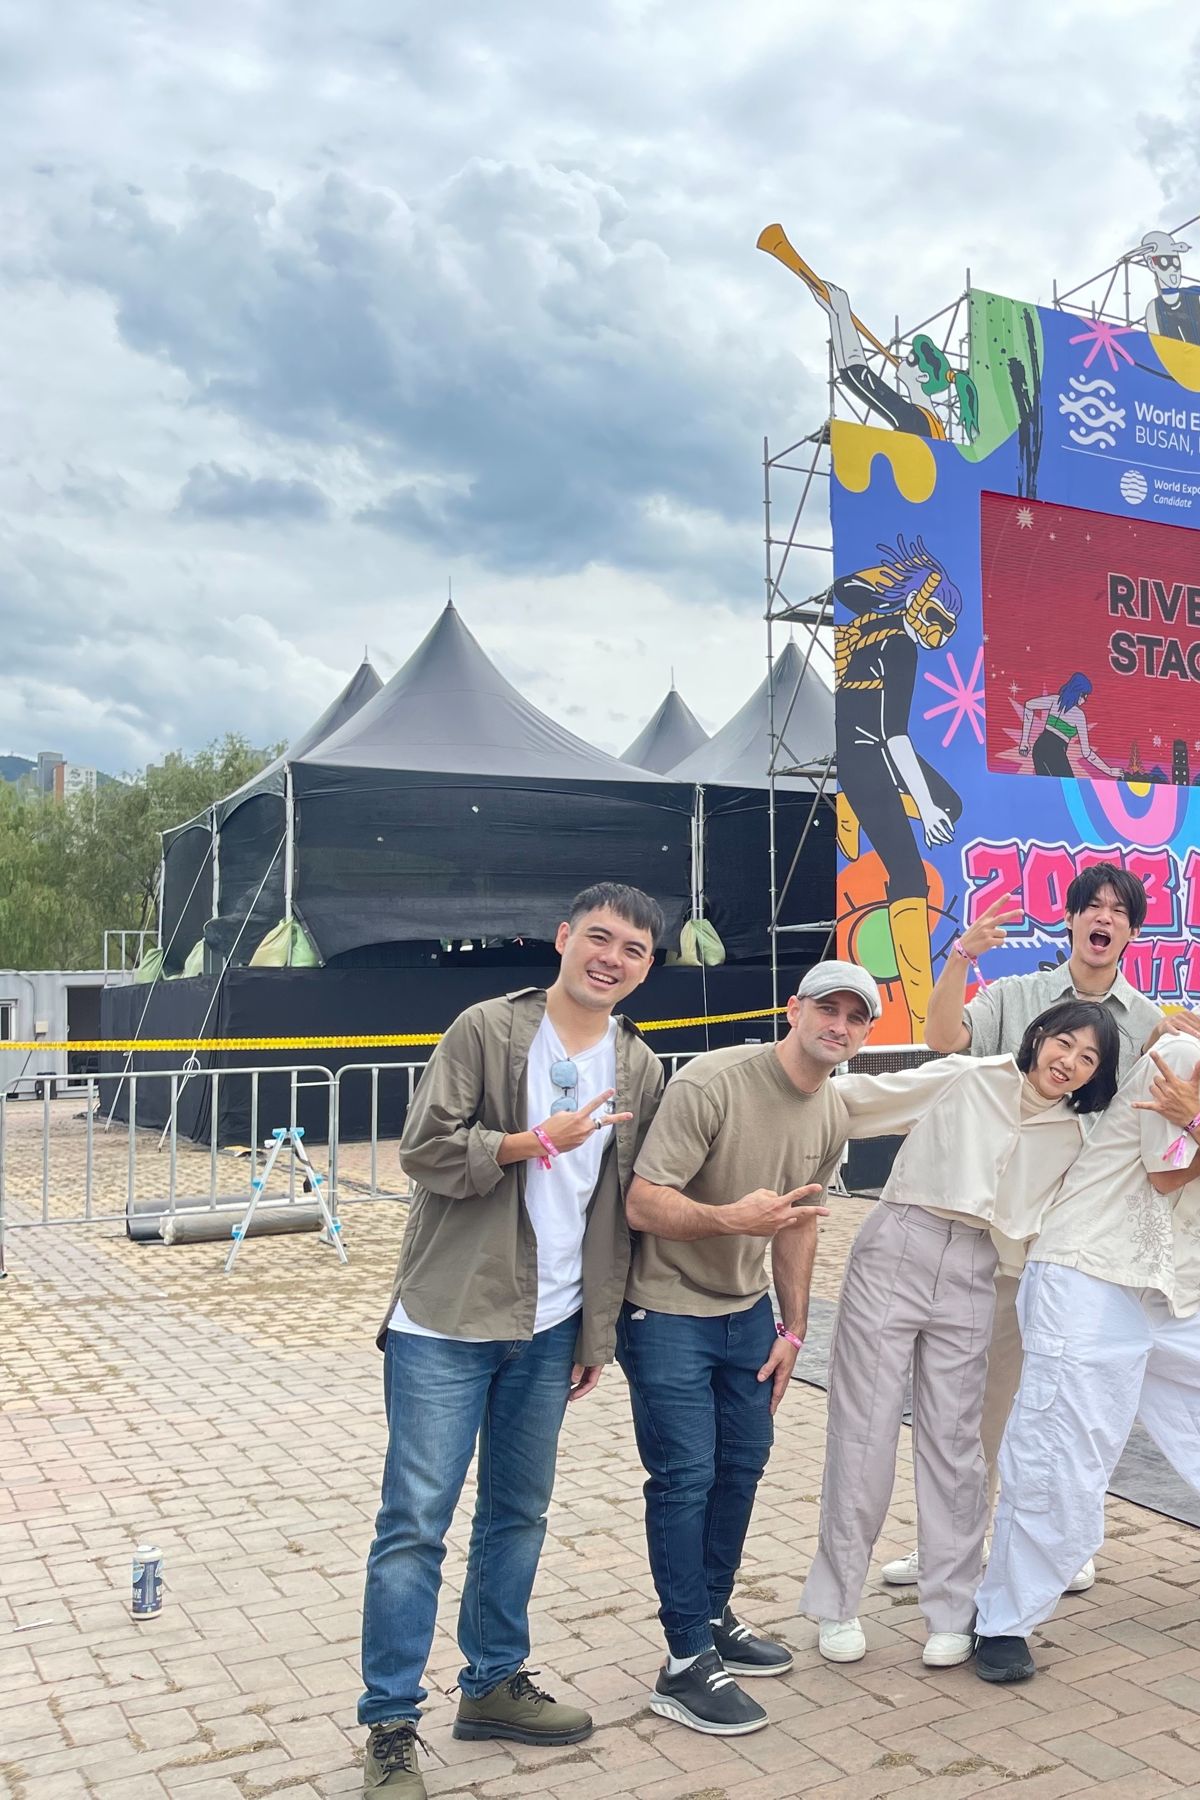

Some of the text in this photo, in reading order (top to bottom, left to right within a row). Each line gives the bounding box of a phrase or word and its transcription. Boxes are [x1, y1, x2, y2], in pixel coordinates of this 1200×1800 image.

[1134, 400, 1187, 430] World
[1135, 425, 1194, 456] BUSAN,
[1153, 479, 1181, 493] World
[1153, 494, 1193, 508] Candidate
